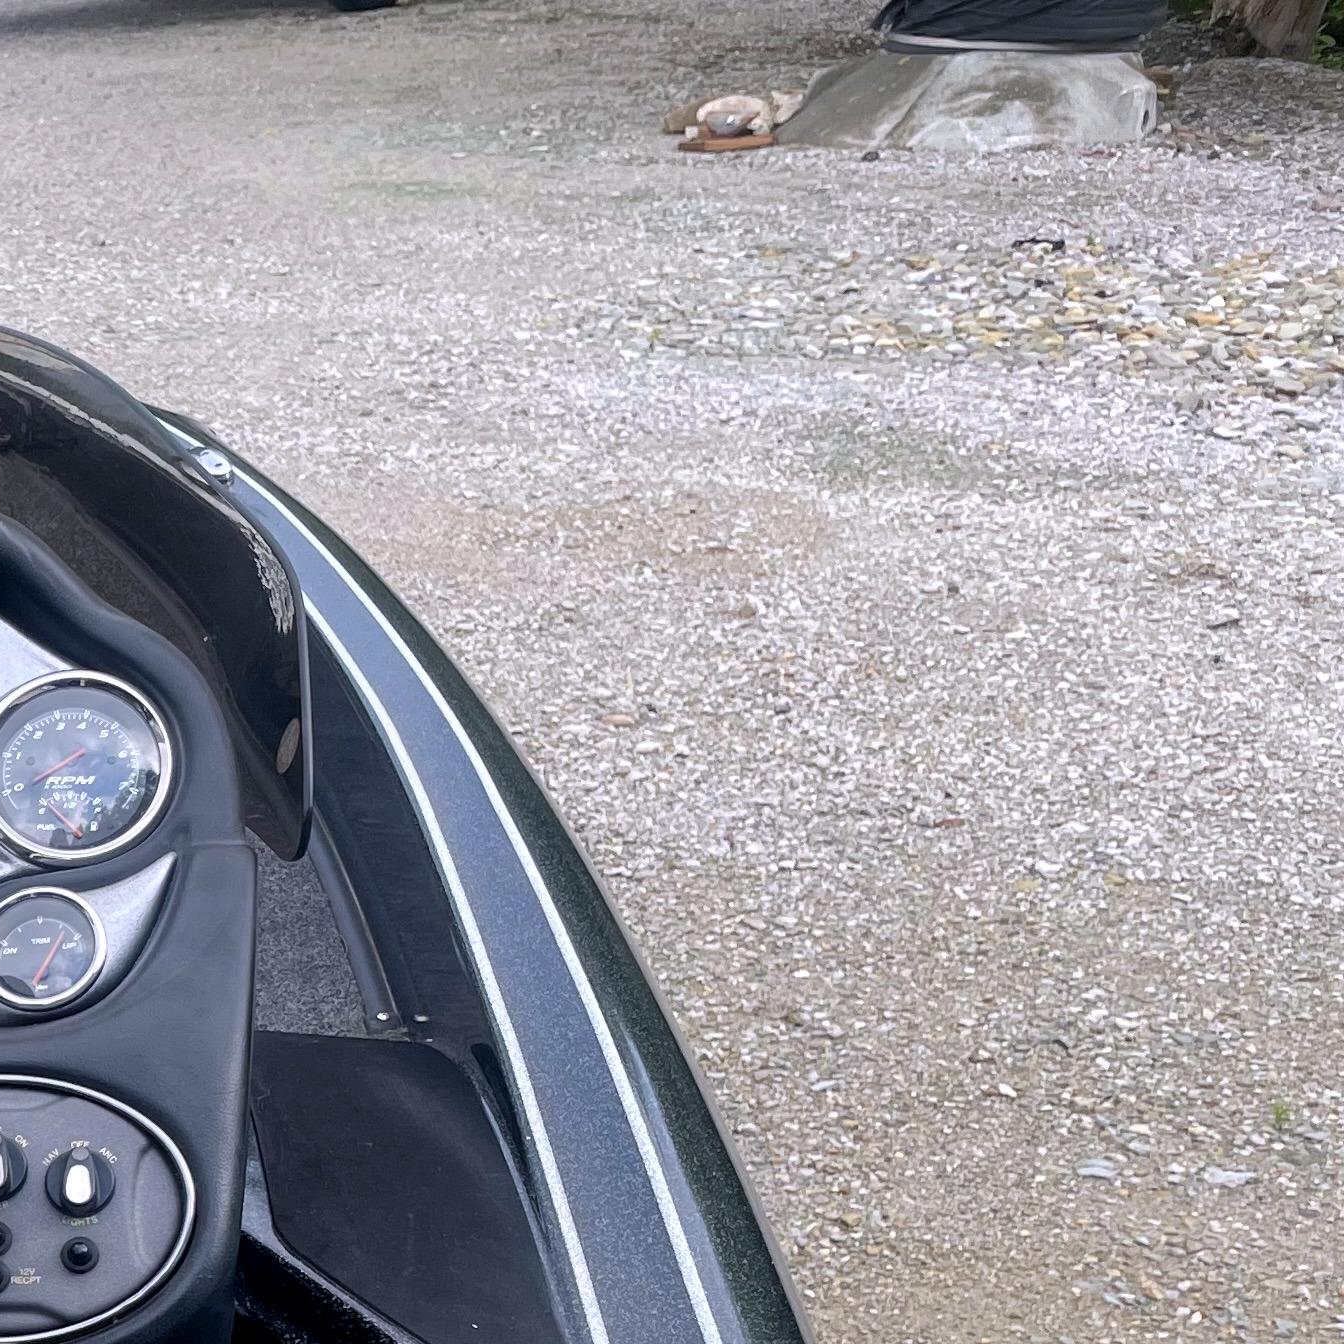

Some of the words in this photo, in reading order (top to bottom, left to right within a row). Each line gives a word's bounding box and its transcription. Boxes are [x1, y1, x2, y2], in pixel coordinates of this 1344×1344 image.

[56, 722, 65, 730] 3
[33, 730, 43, 739] 2
[99, 729, 109, 738] 5
[118, 750, 128, 758] 6
[45, 775, 96, 785] RPM
[14, 783, 24, 791] 0
[31, 937, 51, 945] TRIM
[62, 942, 77, 950] UP
[2, 947, 18, 955] DN
[14, 1135, 28, 1148] ON
[99, 1147, 117, 1164] ANC
[19, 1267, 35, 1276] 12V
[10, 1276, 42, 1285] RECPT
